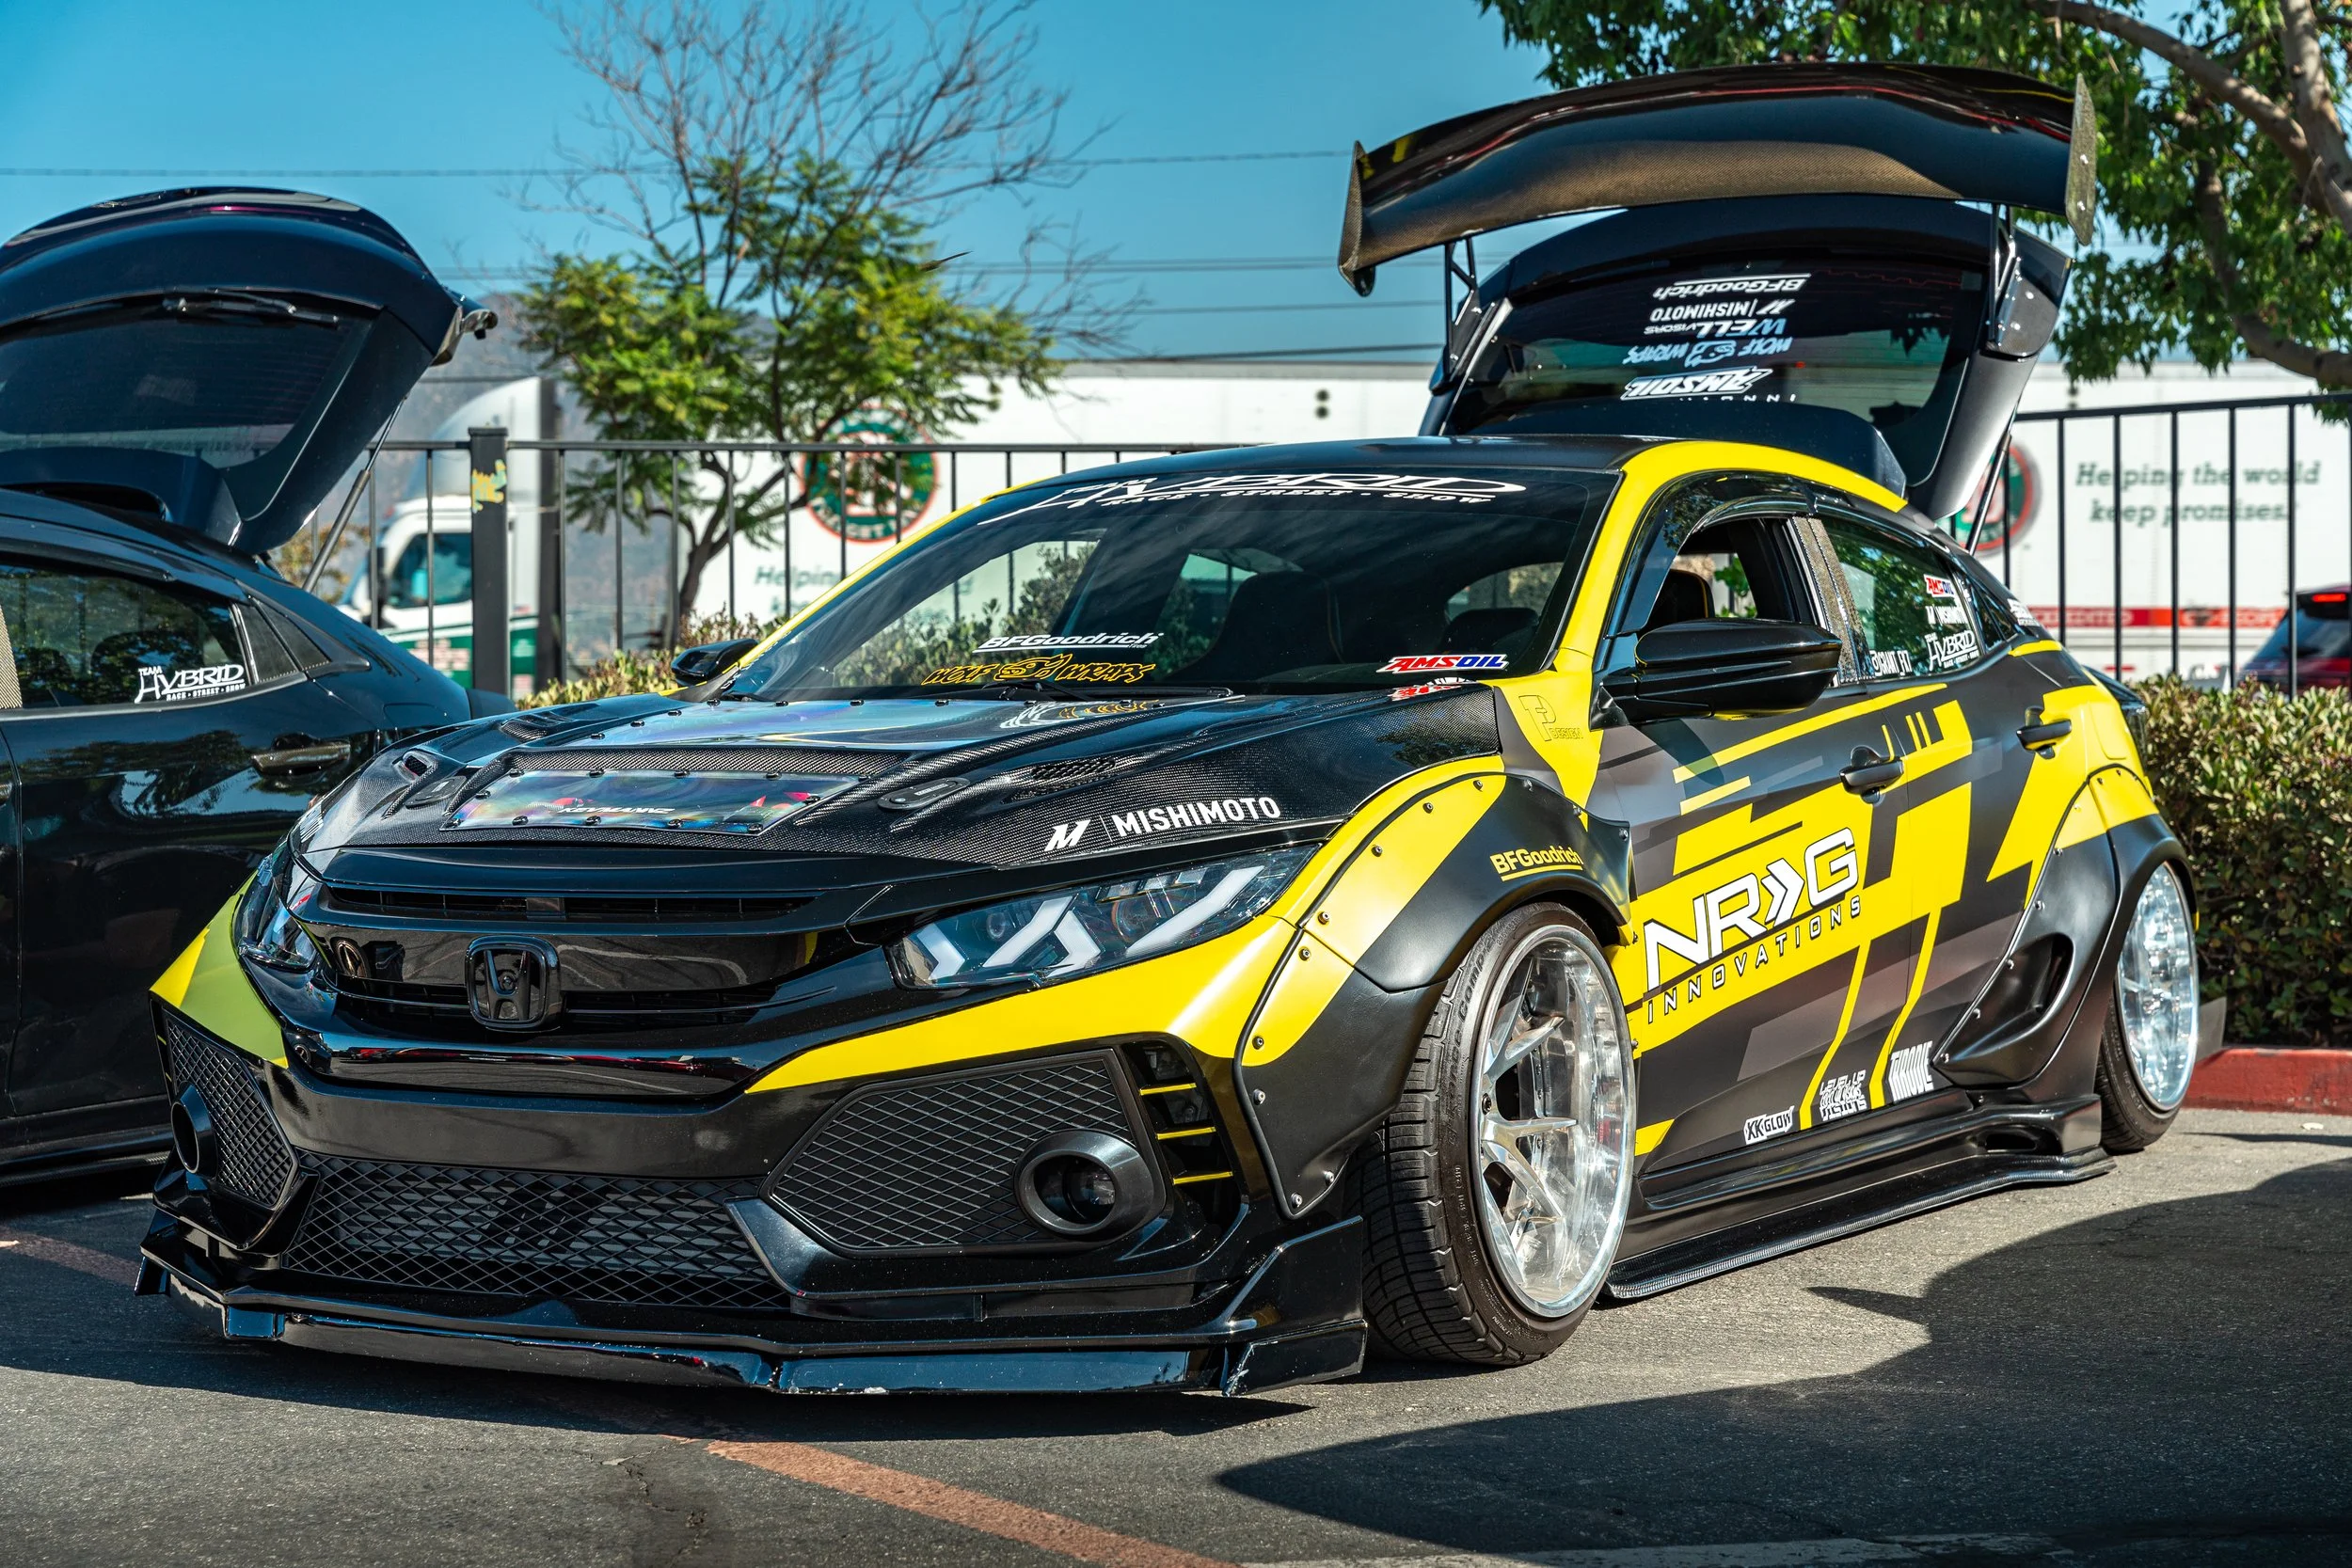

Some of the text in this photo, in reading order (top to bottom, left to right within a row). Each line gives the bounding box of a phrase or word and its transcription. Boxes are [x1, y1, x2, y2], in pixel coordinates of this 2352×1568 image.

[1652, 278, 1806, 299] BFGoodrich
[1650, 301, 1752, 323] MISHIMOTO
[1622, 336, 1793, 365] WOLF WRAPS
[1626, 367, 1768, 399] AMSOIL
[977, 473, 1526, 525] HYBRID
[1383, 492, 1491, 503] SHOW
[1925, 577, 1956, 595] AMSOIL
[978, 632, 1160, 650] BFGoodrich
[1928, 629, 1978, 671] HYBRID
[137, 665, 163, 676] TEAM
[1054, 662, 1157, 684] WRAPS
[1383, 654, 1507, 674] AMSOIL
[134, 664, 245, 704] HYBRID
[167, 683, 246, 702] RACE STREET SHOW
[1111, 797, 1281, 838] MISHIMOTO
[1489, 846, 1584, 875] BFGoodrich
[1647, 895, 1861, 1024] INNOVATIONS
